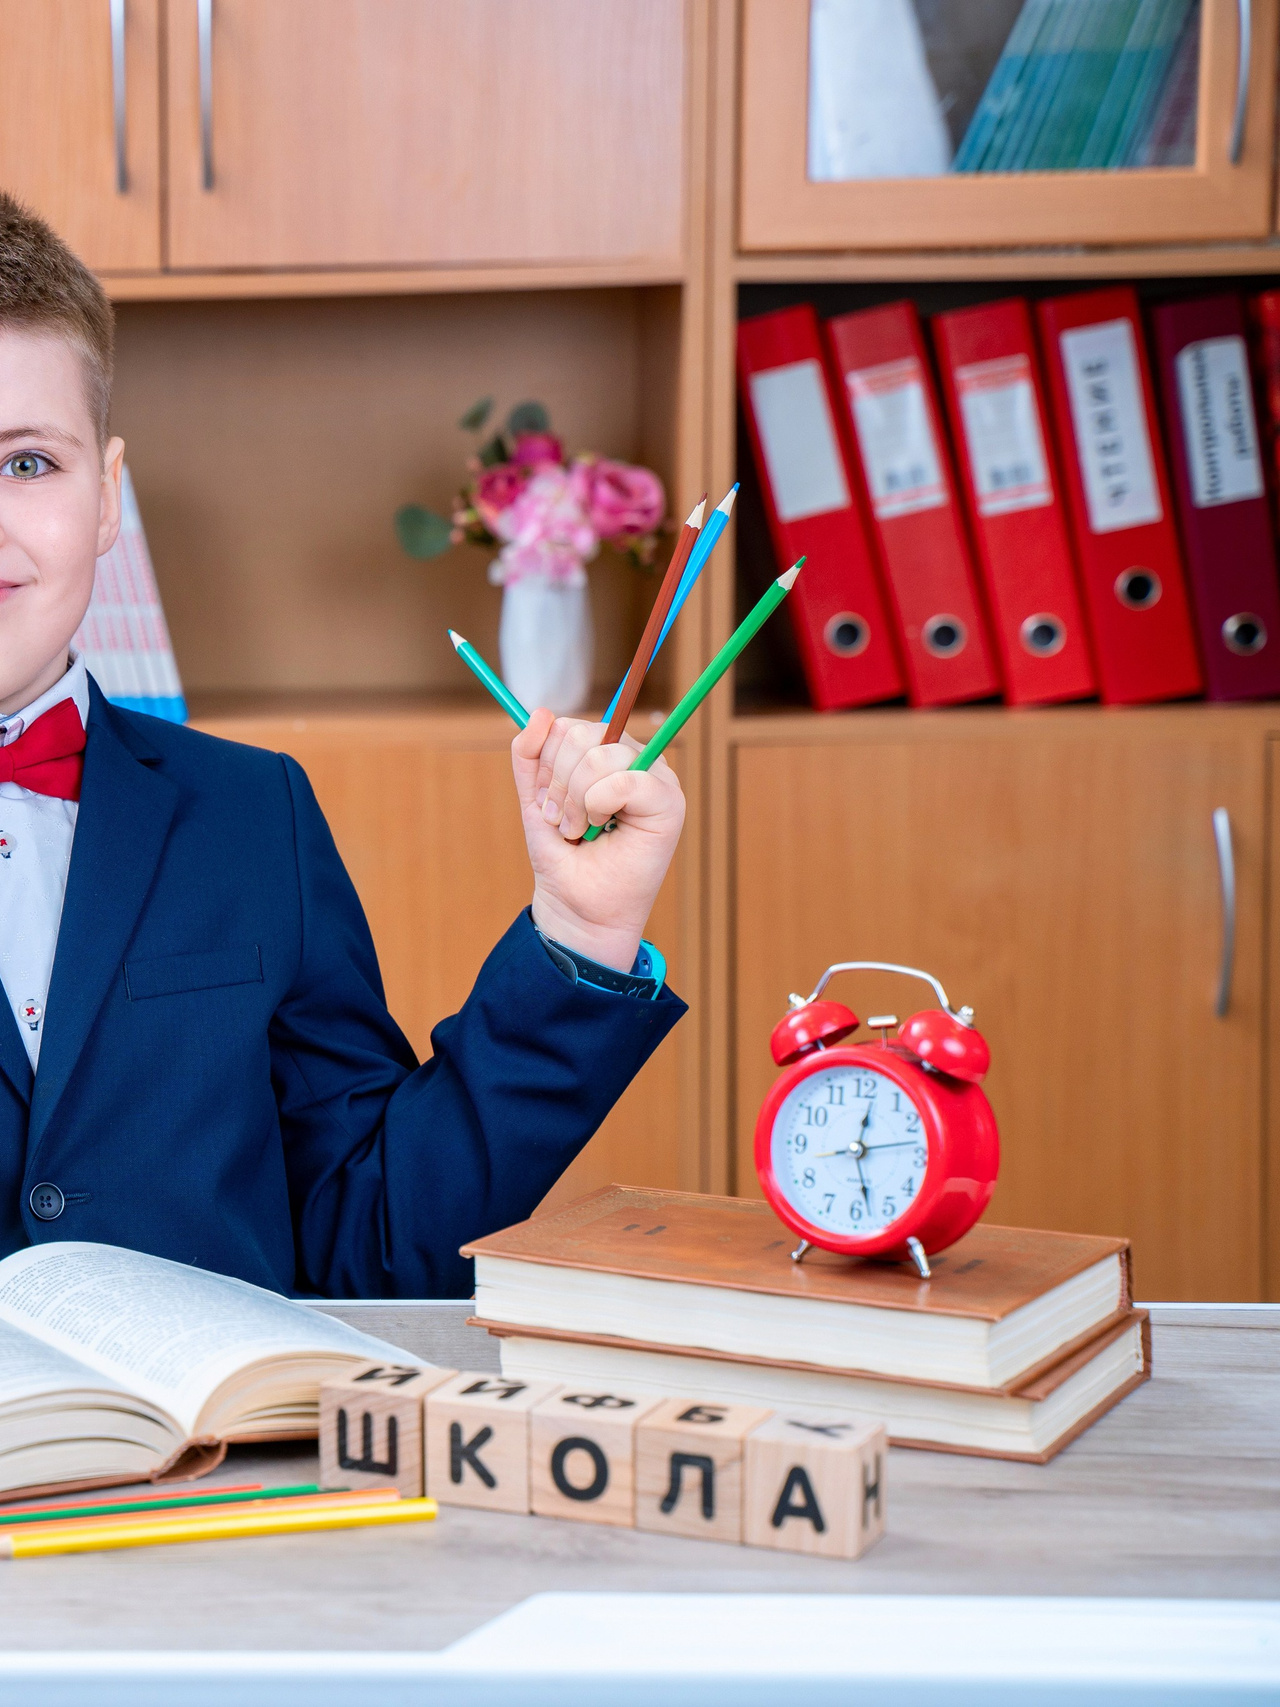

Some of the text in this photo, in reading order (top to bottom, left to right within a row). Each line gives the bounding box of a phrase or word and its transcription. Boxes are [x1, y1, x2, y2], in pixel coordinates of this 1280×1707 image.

[827, 1084, 846, 1106] 11
[853, 1077, 878, 1100] 12
[892, 1091, 902, 1113] 1
[803, 1106, 828, 1128] 10
[905, 1112, 920, 1134] 2
[794, 1133, 808, 1155] 9
[913, 1147, 927, 1169] 3
[802, 1167, 816, 1189] 8
[901, 1176, 915, 1198] 4
[823, 1193, 837, 1215] 7
[849, 1199, 864, 1222] 6
[882, 1196, 897, 1218] 5
